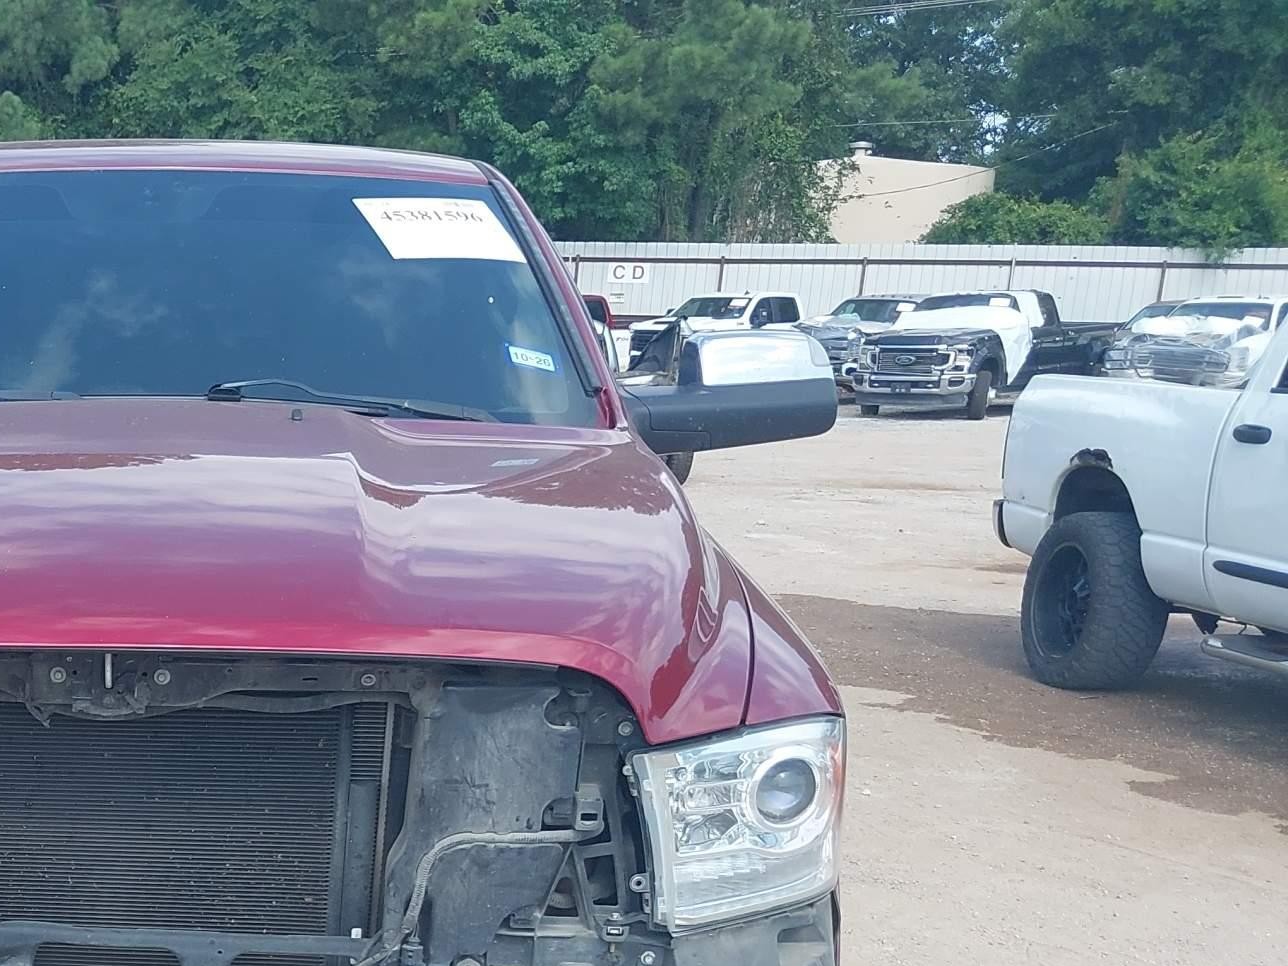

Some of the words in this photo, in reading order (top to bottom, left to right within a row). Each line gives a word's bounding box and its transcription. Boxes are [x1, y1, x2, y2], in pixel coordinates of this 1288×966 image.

[380, 209, 484, 223] 45381596
[613, 265, 626, 280] C
[632, 265, 645, 280] D
